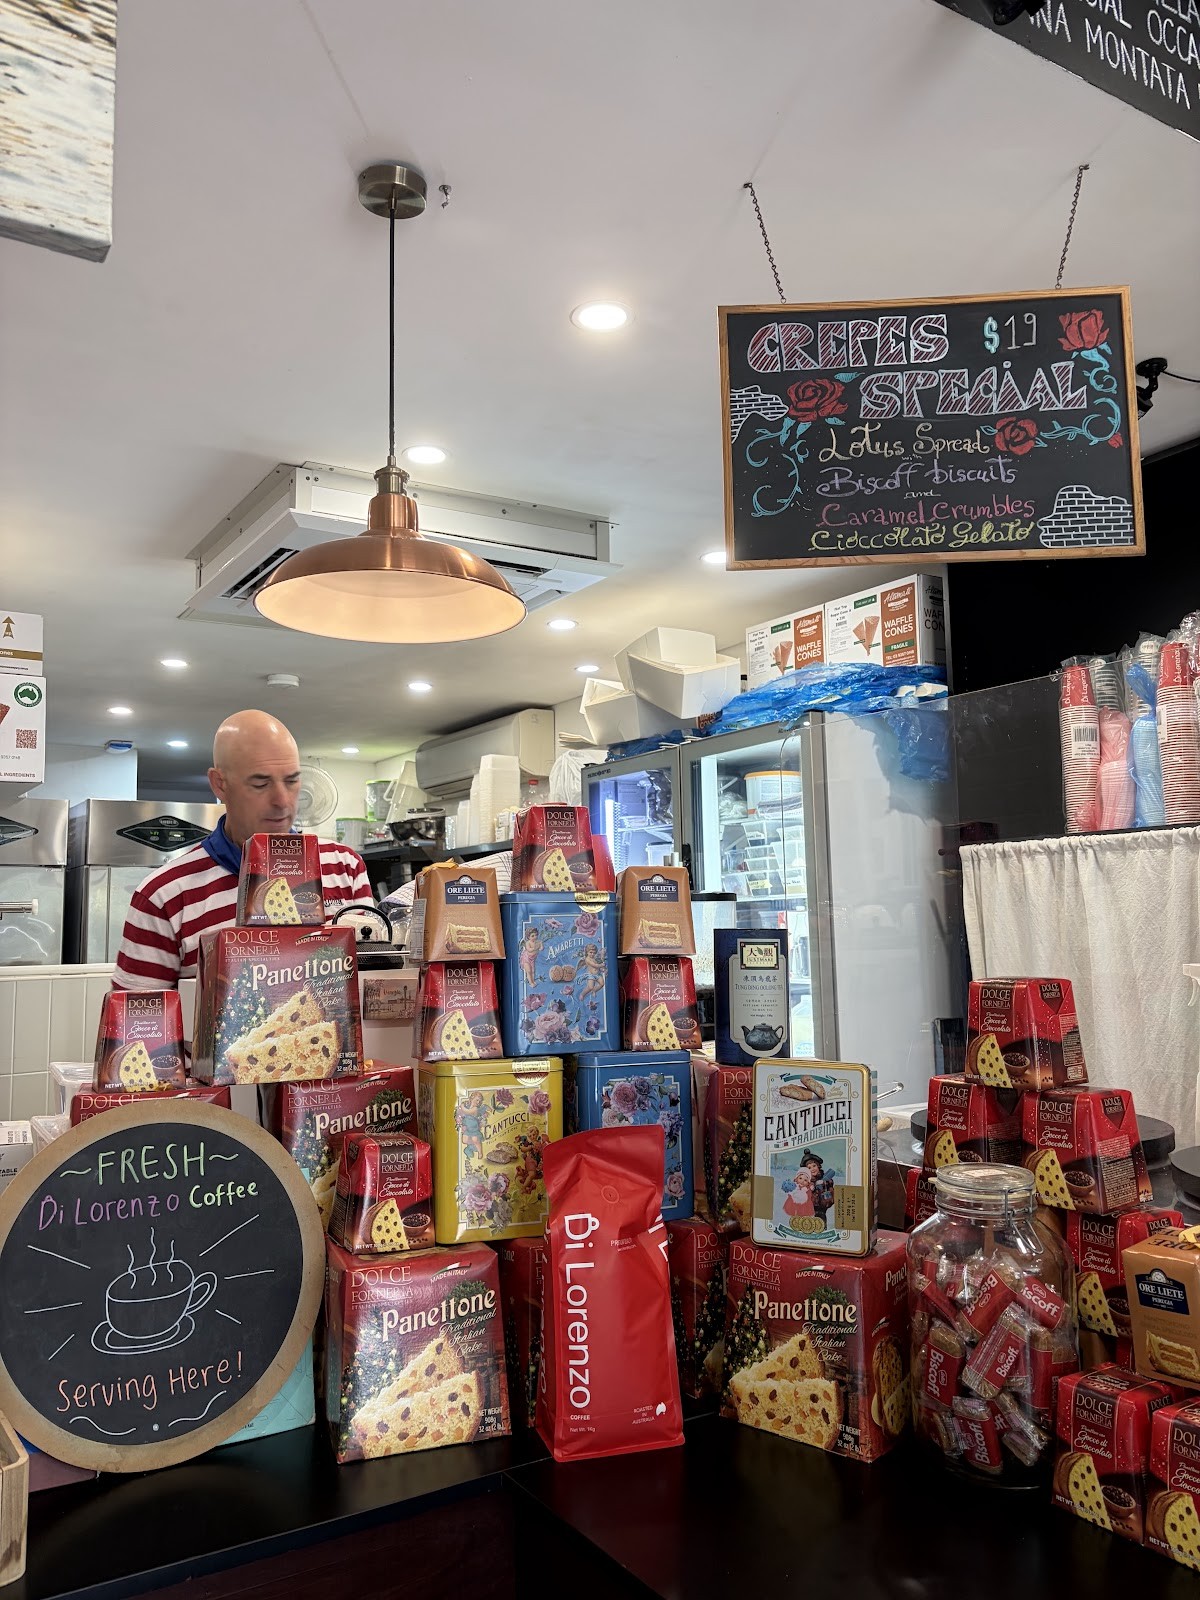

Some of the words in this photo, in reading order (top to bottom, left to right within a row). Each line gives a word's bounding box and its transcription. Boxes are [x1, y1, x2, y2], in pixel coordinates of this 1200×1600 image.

[1085, 18, 1191, 110] MONTATA
[747, 314, 949, 373] CREPES
[983, 312, 1038, 353] $19
[819, 422, 906, 463] Lotus
[913, 422, 990, 460] Spread
[816, 463, 925, 498] Biscoff
[925, 456, 1017, 491] biscuits
[904, 488, 940, 499] and
[816, 500, 935, 528] Caramel
[930, 495, 1036, 521] Crumbles
[809, 521, 946, 551] Cioccolato
[949, 520, 1036, 550] Gelato
[884, 614, 913, 629] WAFFLE
[884, 624, 914, 638] CONES
[797, 640, 821, 653] WAFFLE
[891, 642, 908, 651] FRAGILE
[797, 648, 821, 661] CONES
[546, 811, 574, 820] DOLCE
[271, 839, 302, 848] DOLCE
[225, 930, 280, 945] DOLCE
[295, 937, 310, 946] MADE
[225, 946, 280, 957] FORNERIA
[546, 937, 584, 961] AMARETTI
[251, 955, 353, 991] Panettone
[447, 968, 478, 978] DOLCE
[650, 964, 678, 973] DOLCE
[302, 970, 354, 991] Traditional
[1042, 983, 1059, 991] DOLCE
[312, 986, 345, 998] Italian
[982, 989, 1011, 1000] DOLCE
[128, 999, 162, 1009] DOLCE
[318, 997, 341, 1009] Cake
[447, 1000, 479, 1008] Cioccolato
[982, 1000, 1010, 1009] FORNERIA
[128, 1009, 162, 1017] FORNERIA
[127, 1031, 162, 1040] Cioccolato
[981, 1024, 1011, 1033] Cioccolato
[288, 1079, 341, 1094] DOLCE
[356, 1083, 368, 1092] MADE
[941, 1085, 969, 1099] DOLCE
[289, 1094, 341, 1107] FORNERIA
[941, 1096, 968, 1108] FORNERIA
[1104, 1097, 1121, 1107] DOLCE
[1040, 1101, 1072, 1115] DOLCE
[315, 1098, 411, 1140] Panettone
[365, 1113, 414, 1134] Traditional
[764, 1101, 852, 1141] CANTUCCI
[1040, 1112, 1072, 1123] FORNERIA
[484, 1112, 529, 1140] CANTUCCI
[939, 1119, 967, 1131] Cioccolato
[791, 1121, 853, 1146] TRADIZIONALI
[1038, 1138, 1074, 1149] Cioccolato
[98, 1141, 205, 1186] FRESH
[381, 1153, 413, 1163] DOLCE
[382, 1164, 413, 1173] FORNERIA
[379, 1188, 413, 1197] Cioccolato
[39, 1195, 64, 1231] Di
[74, 1193, 180, 1226] Lorenzo
[189, 1181, 259, 1209] Coffee
[564, 1213, 600, 1249] Di
[1082, 1220, 1115, 1239] DOLCE
[1082, 1232, 1114, 1248] FORNERIA
[733, 1246, 781, 1271] DOLCE
[733, 1264, 780, 1284] FORNERIA
[1082, 1259, 1116, 1275] Cioccolato
[351, 1265, 413, 1287] DOLCE
[430, 1273, 446, 1284] MADE
[816, 1272, 831, 1280] ITALY
[351, 1287, 413, 1302] FORNERIA
[1139, 1282, 1157, 1295] ORE
[1158, 1286, 1185, 1299] LIETE
[754, 1290, 857, 1323] Panettone
[1021, 1287, 1061, 1318] iscoff
[1152, 1297, 1173, 1306] PERUGIA
[381, 1289, 496, 1342] Panettone
[439, 1308, 496, 1335] Traditional
[802, 1321, 858, 1335] Traditional
[449, 1328, 486, 1347] Italian
[565, 1262, 595, 1409] Lorenzo
[811, 1336, 846, 1349] Italian
[456, 1342, 483, 1358] Cake
[817, 1349, 842, 1361] Cake
[995, 1346, 1019, 1378] Biscoff
[928, 1350, 944, 1397] Biscoff
[56, 1372, 157, 1412] Serving
[168, 1351, 244, 1396] Here!
[633, 1405, 654, 1413] ROASTED
[1076, 1393, 1113, 1417] DOLCE
[632, 1416, 655, 1425] AUSTRALIA
[1075, 1408, 1112, 1429] FORNERIA
[969, 1422, 990, 1465] Biscoff
[1074, 1438, 1113, 1459] Cioccolato
[1149, 1537, 1160, 1546] NET
[1160, 1542, 1170, 1550] WT
